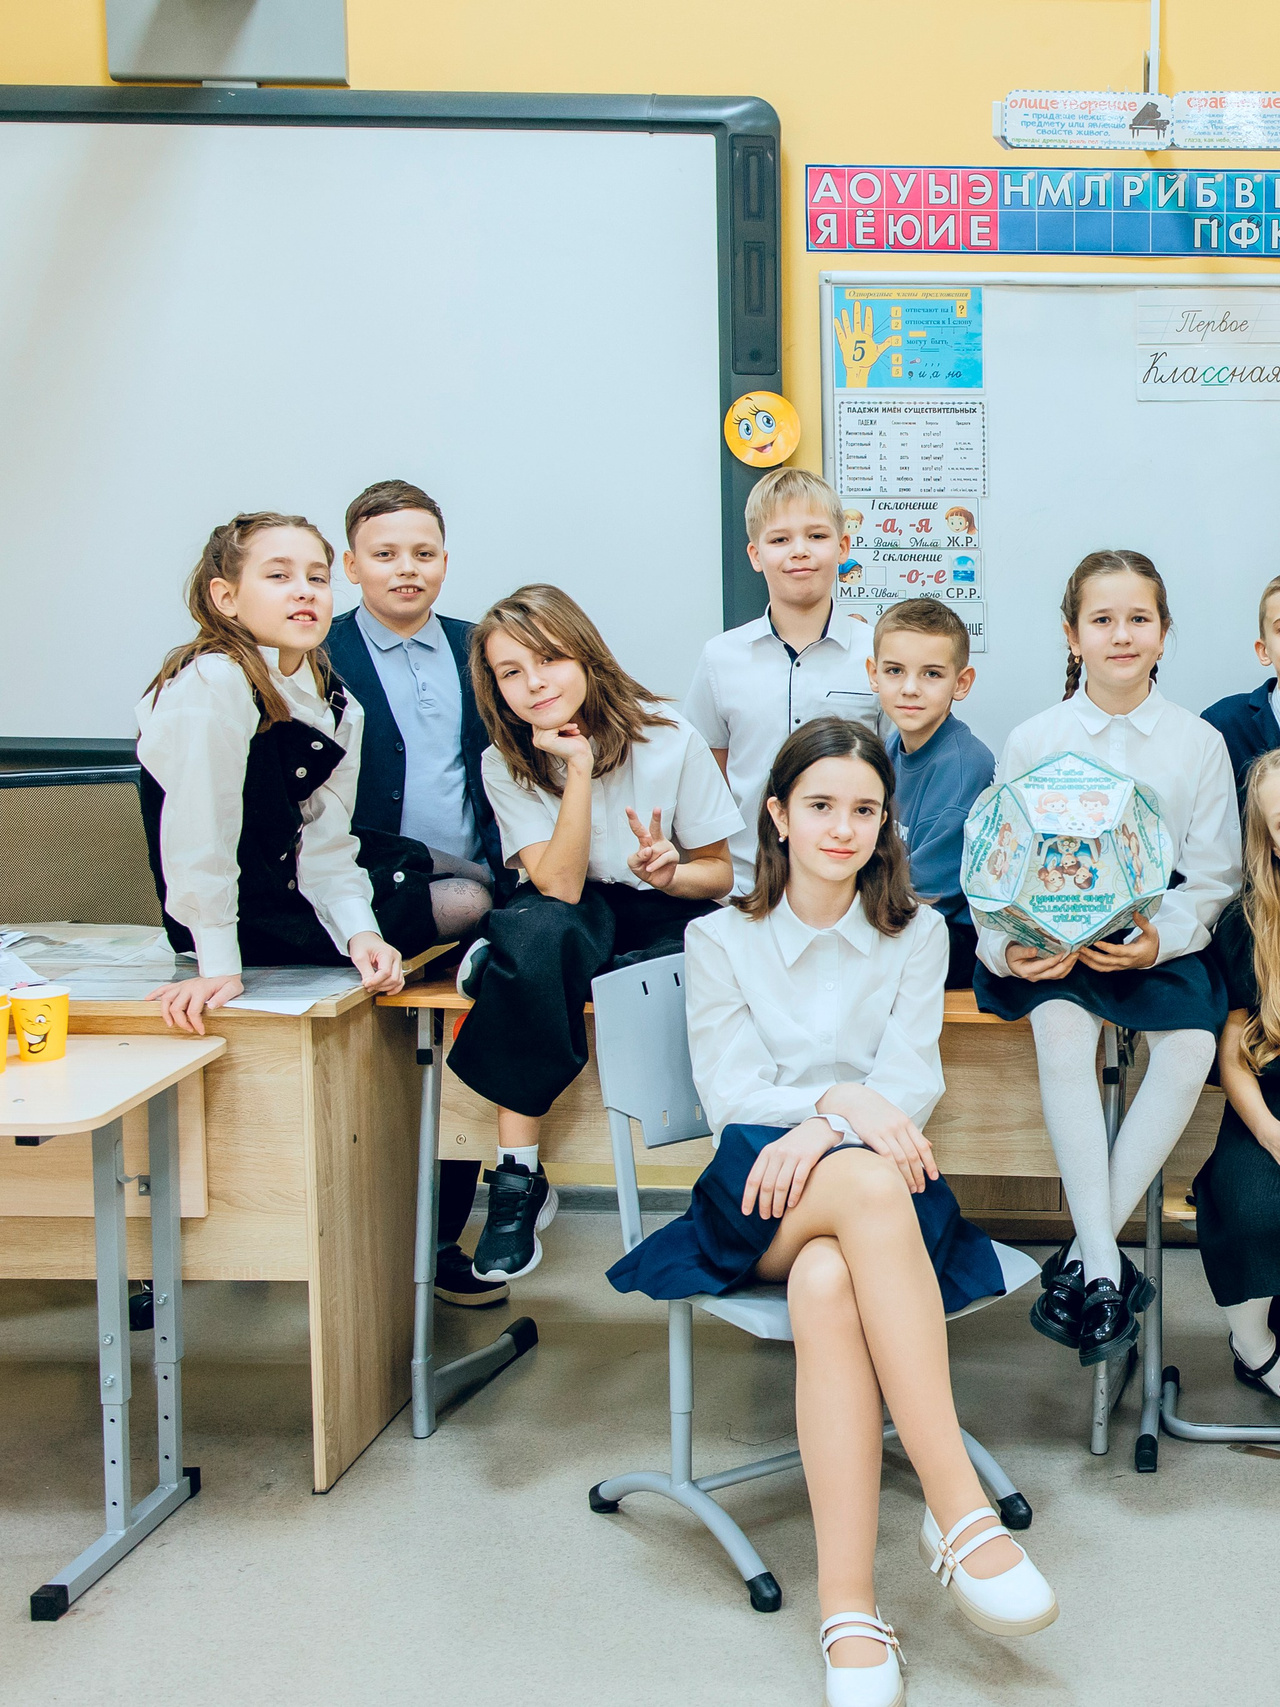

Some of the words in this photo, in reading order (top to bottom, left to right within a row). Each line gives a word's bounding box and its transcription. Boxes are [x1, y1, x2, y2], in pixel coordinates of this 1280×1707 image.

[812, 172, 842, 205] А
[849, 172, 882, 205] О
[891, 173, 916, 205] У
[928, 174, 958, 205] Ы
[968, 174, 993, 205] Э
[1003, 175, 1031, 206] Н
[1037, 175, 1072, 207] М
[1079, 176, 1106, 207] Л
[1123, 176, 1145, 207] Р
[1158, 173, 1185, 208] Й
[1196, 177, 1218, 208] Б
[1235, 179, 1257, 208] В
[816, 215, 839, 244] Я
[856, 210, 875, 245] Ё
[888, 215, 921, 245] Ю
[929, 216, 955, 246] И
[969, 216, 990, 246] Е
[1194, 218, 1218, 248] П
[1228, 218, 1260, 249] Ф
[1176, 310, 1248, 341] Первое
[852, 340, 866, 361] 5
[878, 501, 938, 511] склонение
[874, 538, 899, 547] Ваня
[910, 538, 939, 547] Мила
[947, 536, 977, 547] Ж.Р.
[873, 551, 880, 561] 2
[883, 553, 943, 562] склонение
[840, 587, 869, 598] М.Р.
[871, 588, 898, 598] Иван
